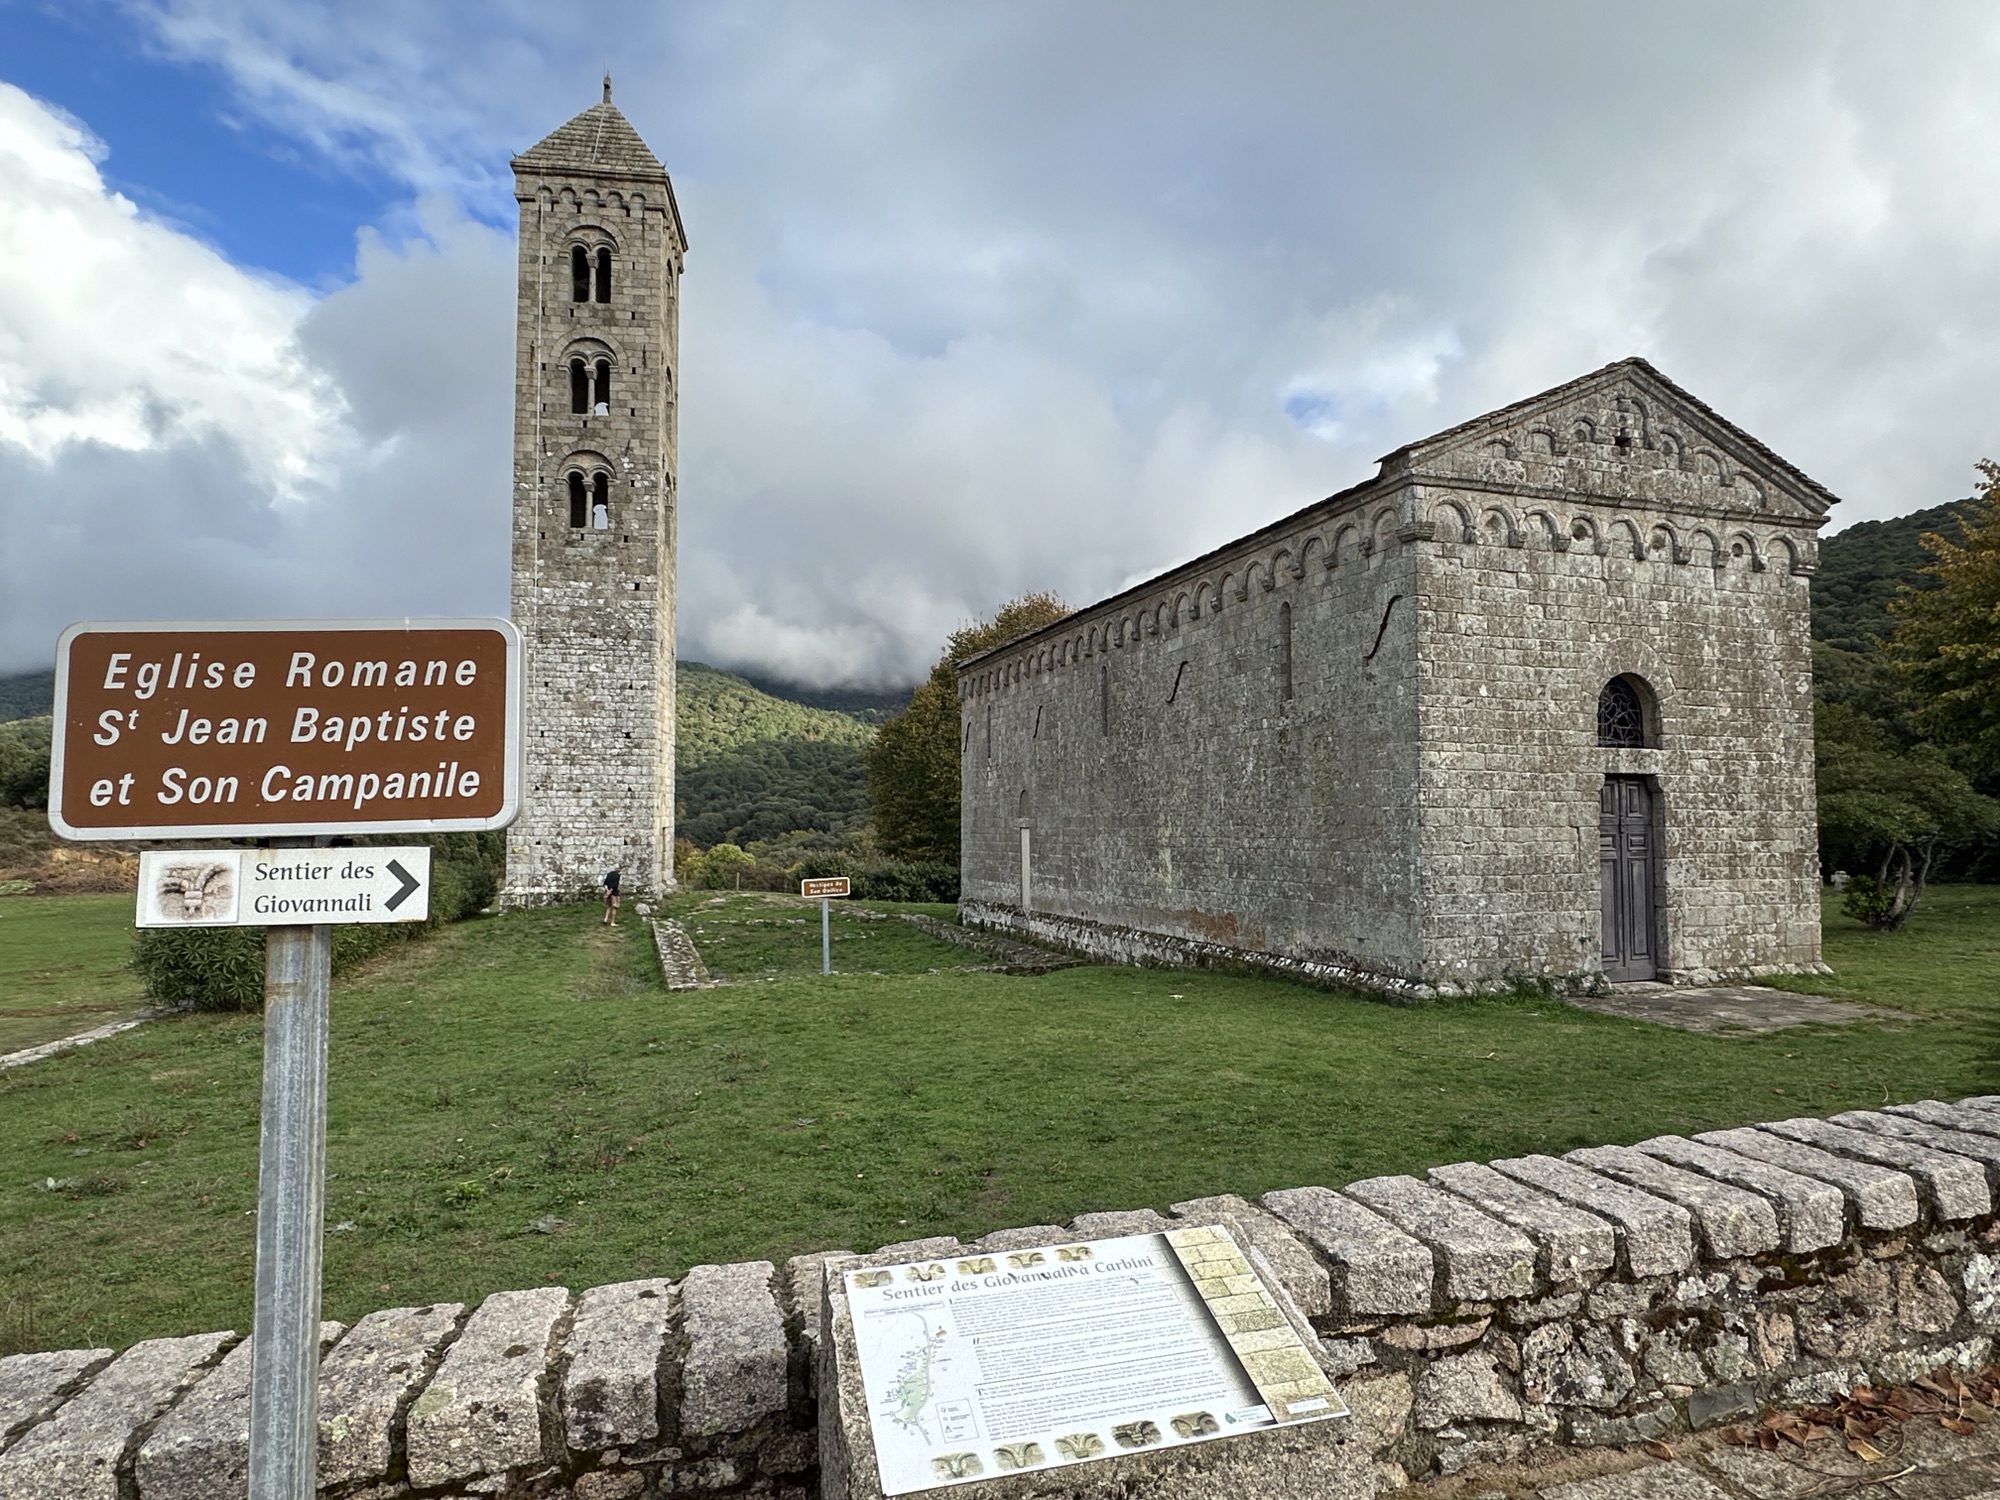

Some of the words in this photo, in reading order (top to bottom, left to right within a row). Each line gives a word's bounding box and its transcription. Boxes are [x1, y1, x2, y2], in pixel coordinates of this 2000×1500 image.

[104, 653, 256, 699] Eglise
[286, 652, 477, 688] Romane
[93, 709, 139, 746] St
[162, 709, 268, 745] Jean
[291, 706, 475, 751] Baptiste
[90, 772, 135, 807] et
[157, 767, 239, 805] Son
[261, 762, 480, 810] Campanile
[255, 862, 333, 881] Sentier
[340, 861, 375, 880] des
[254, 893, 372, 914] Giovannali
[882, 1284, 945, 1301] Sentier
[951, 1280, 978, 1293] des
[1079, 1264, 1090, 1276] à
[1094, 1255, 1154, 1274] Carbini
